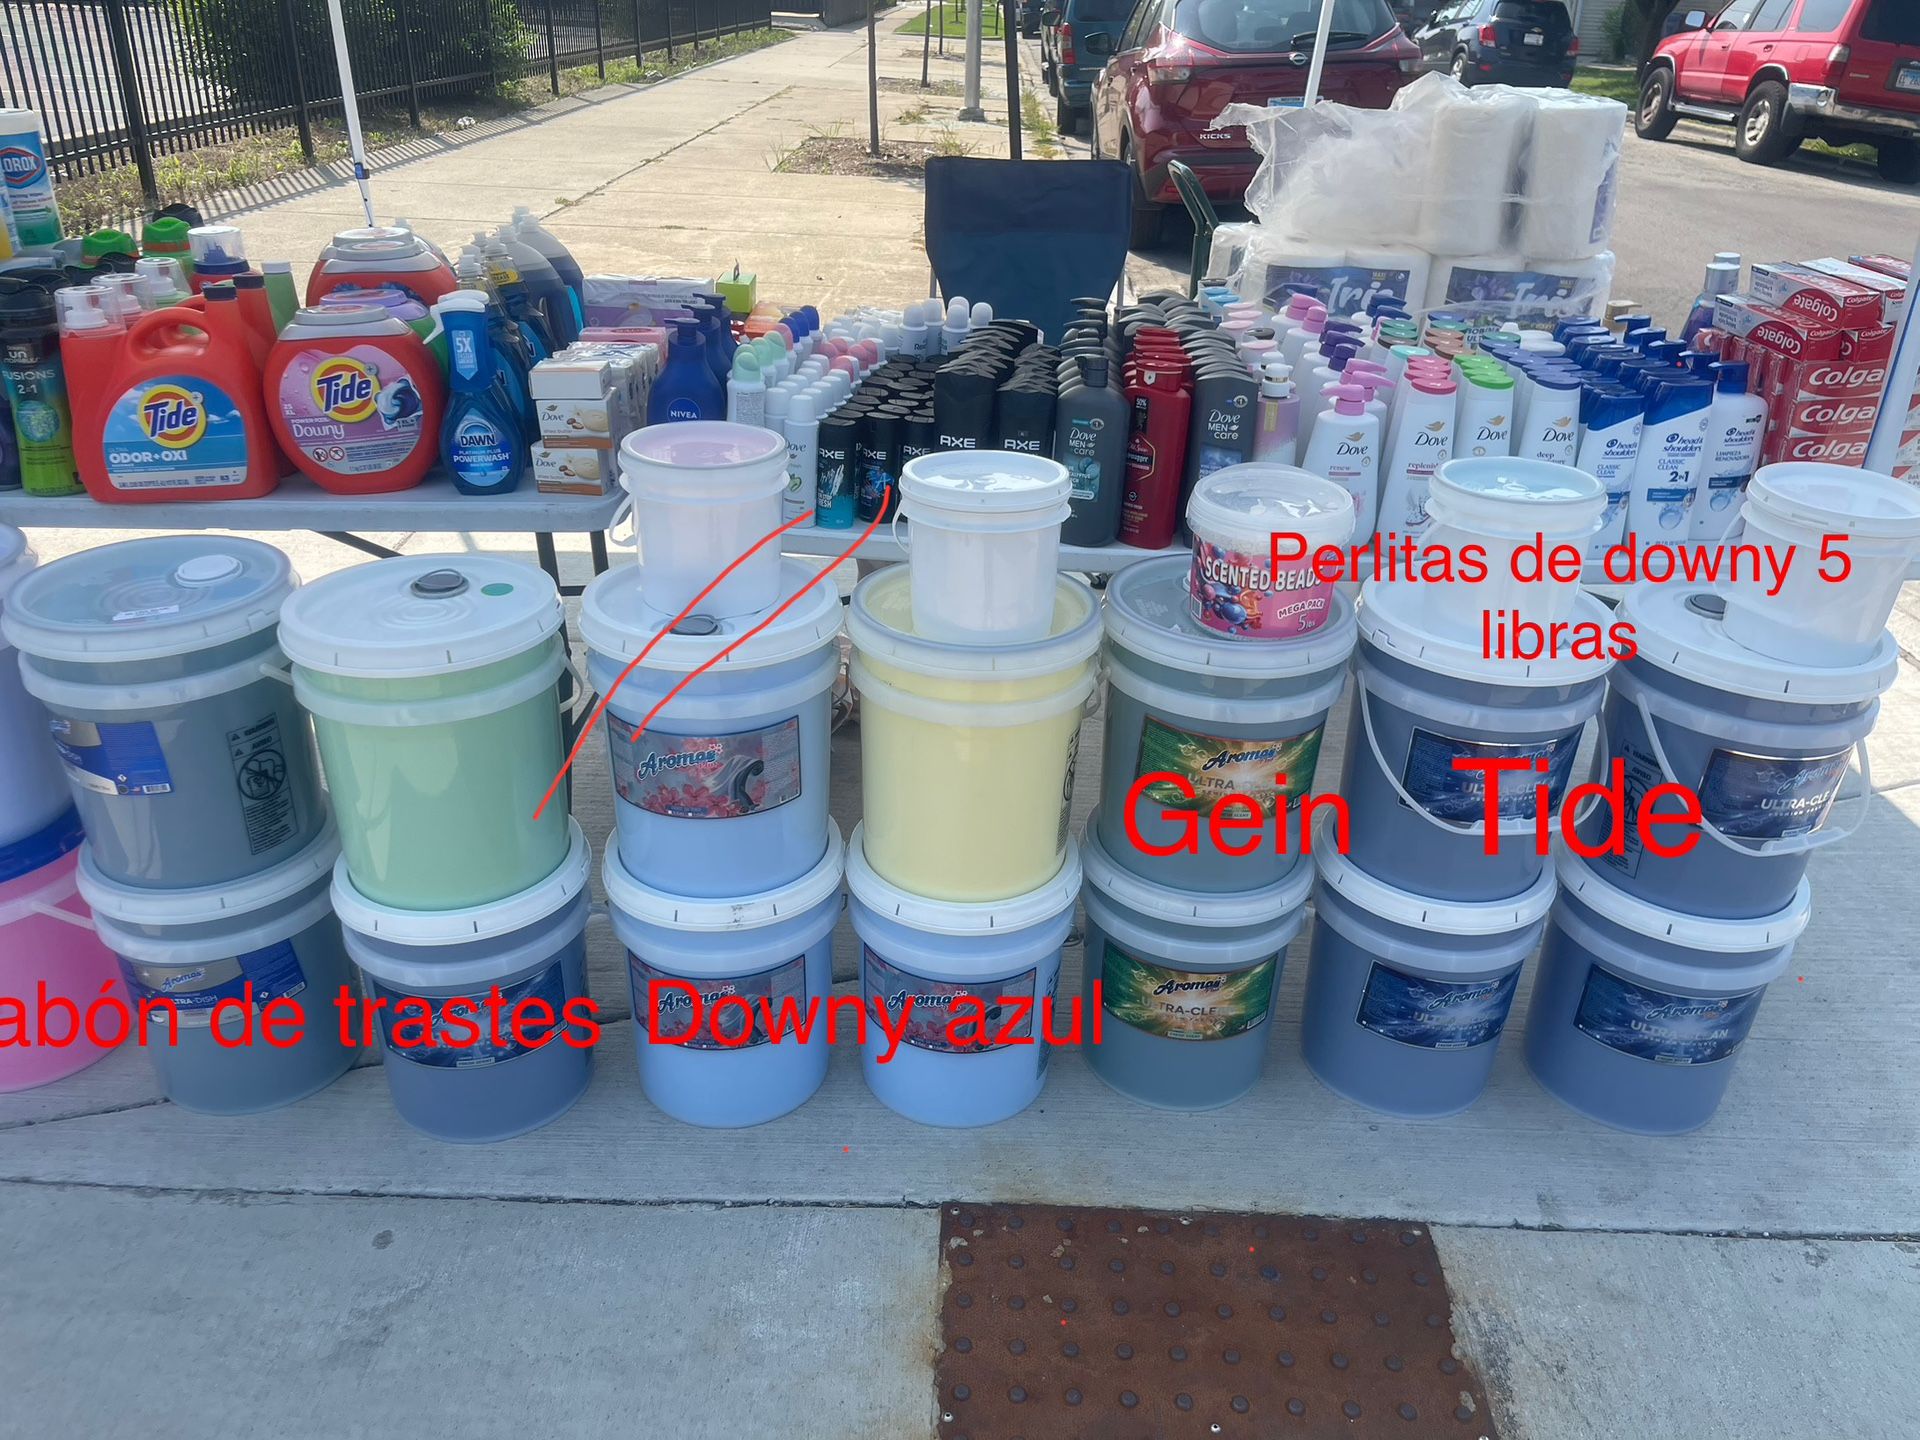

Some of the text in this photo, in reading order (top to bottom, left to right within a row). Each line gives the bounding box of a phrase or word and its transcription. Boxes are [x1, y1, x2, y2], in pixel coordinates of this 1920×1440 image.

[1794, 294, 1838, 322] Colgate
[1757, 326, 1801, 355] Colgate
[317, 372, 372, 414] Tide
[144, 401, 198, 438] Tide
[542, 411, 564, 421] Dove
[670, 410, 698, 419] NIVEA
[1208, 409, 1241, 423] Dove
[293, 424, 345, 440] Downy
[1070, 427, 1097, 441] Dove
[1208, 423, 1229, 432] MEN
[1477, 426, 1508, 441] Dove
[1542, 427, 1574, 442] Dove
[460, 433, 496, 447] DAWN
[940, 434, 976, 449] AXE
[1214, 432, 1239, 440] care
[1415, 431, 1448, 446] Dove
[1003, 439, 1041, 451] AXE
[1069, 440, 1086, 448] MEN
[1336, 441, 1368, 456] Dove
[453, 453, 510, 463] POWERWASH
[819, 448, 845, 459] AXE
[1074, 448, 1095, 456] care
[1204, 555, 1271, 591] SCENTED
[1278, 601, 1306, 618] MEGA
[1297, 613, 1307, 632] 5
[173, 994, 218, 1005] LTRA-DISH
